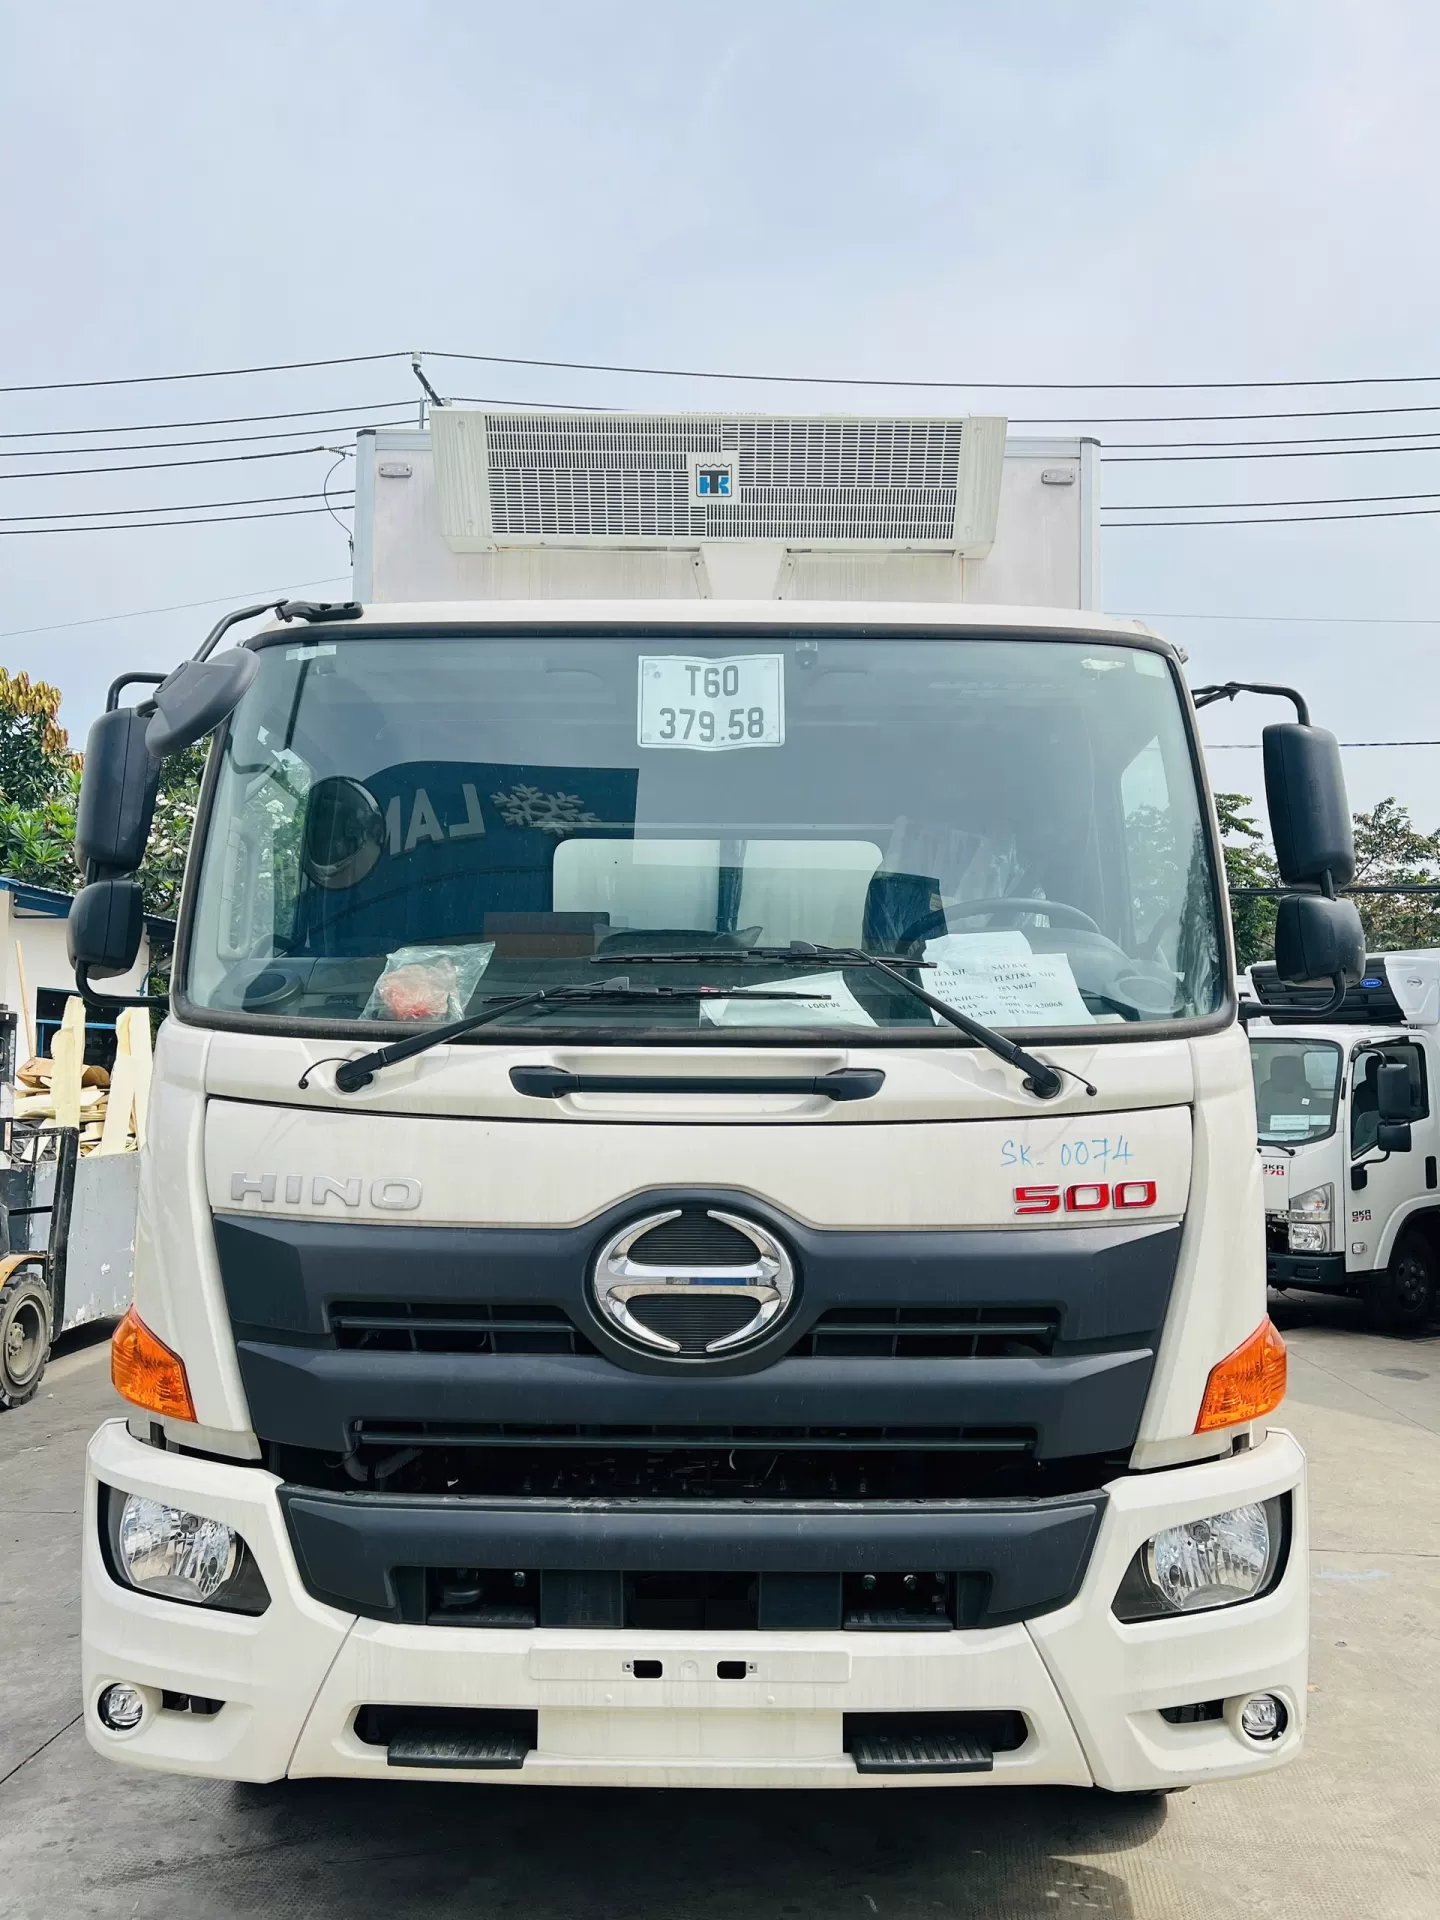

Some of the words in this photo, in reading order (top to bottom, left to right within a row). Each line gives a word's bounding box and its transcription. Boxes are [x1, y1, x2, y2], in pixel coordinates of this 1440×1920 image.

[685, 665, 739, 698] T60
[659, 707, 764, 742] 379.58
[1060, 1135, 1135, 1174] 0074
[231, 1172, 423, 1211] HINO
[1014, 1179, 1157, 1215] 500
[1352, 1209, 1371, 1217] QKR
